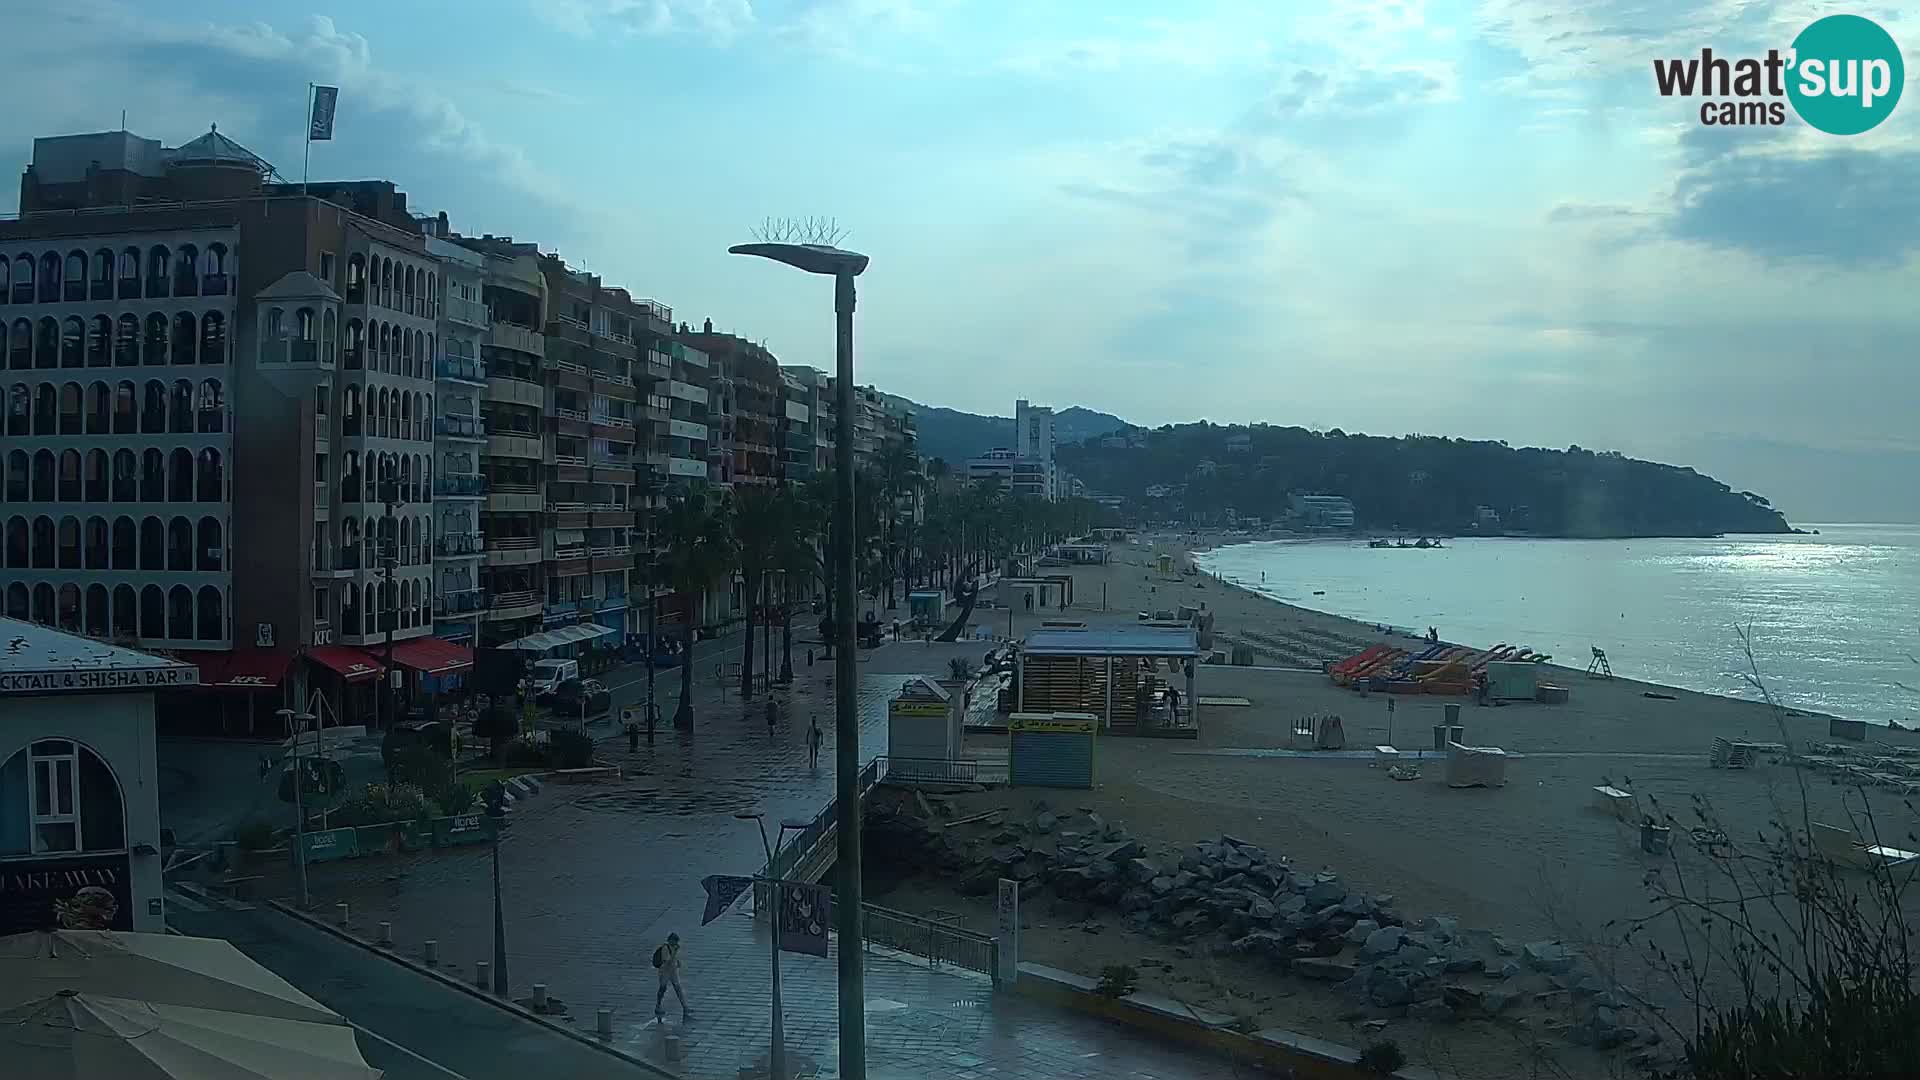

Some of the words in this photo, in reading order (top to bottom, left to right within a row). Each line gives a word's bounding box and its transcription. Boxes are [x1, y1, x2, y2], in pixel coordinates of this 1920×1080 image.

[313, 629, 333, 646] KFC
[63, 673, 74, 687] &
[79, 671, 140, 688] SHISHA
[145, 670, 178, 684] BAR
[230, 676, 267, 684] KFC
